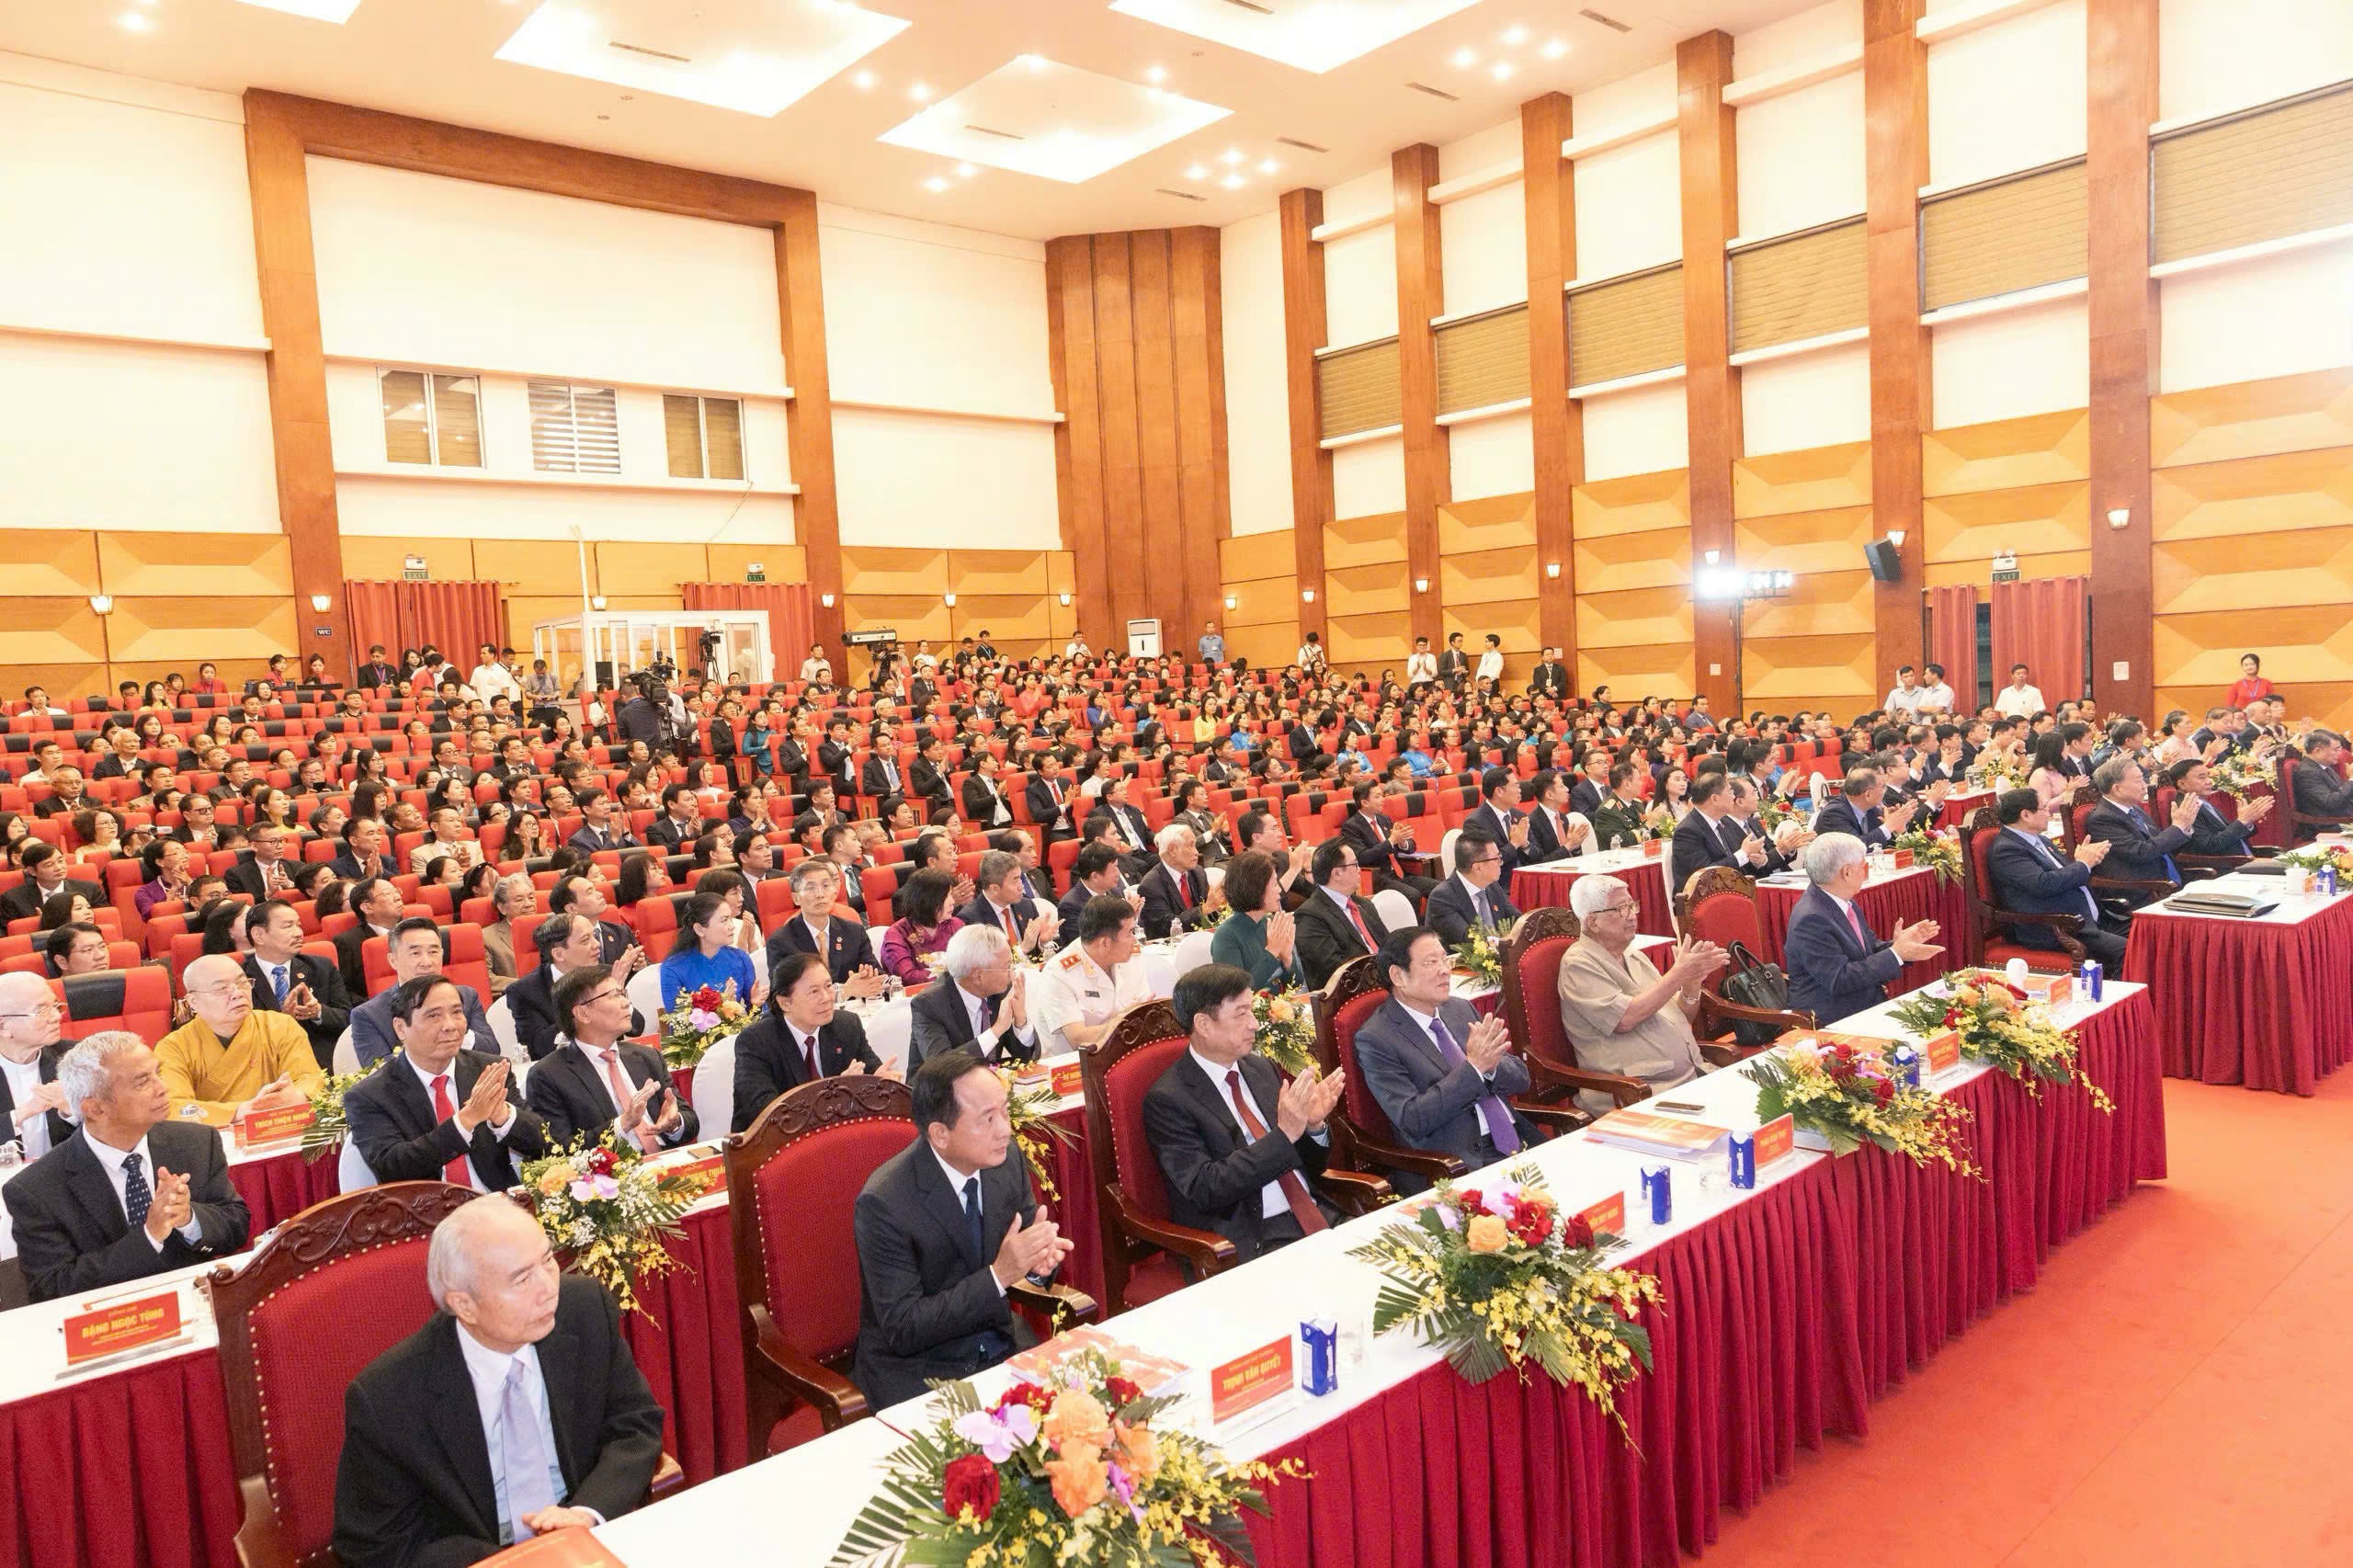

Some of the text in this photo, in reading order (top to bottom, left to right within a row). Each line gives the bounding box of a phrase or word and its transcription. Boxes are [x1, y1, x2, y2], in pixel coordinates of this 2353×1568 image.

[1993, 571, 2018, 581] EXIT
[110, 1314, 139, 1330] NGỌC
[139, 1308, 165, 1324] TÙNG
